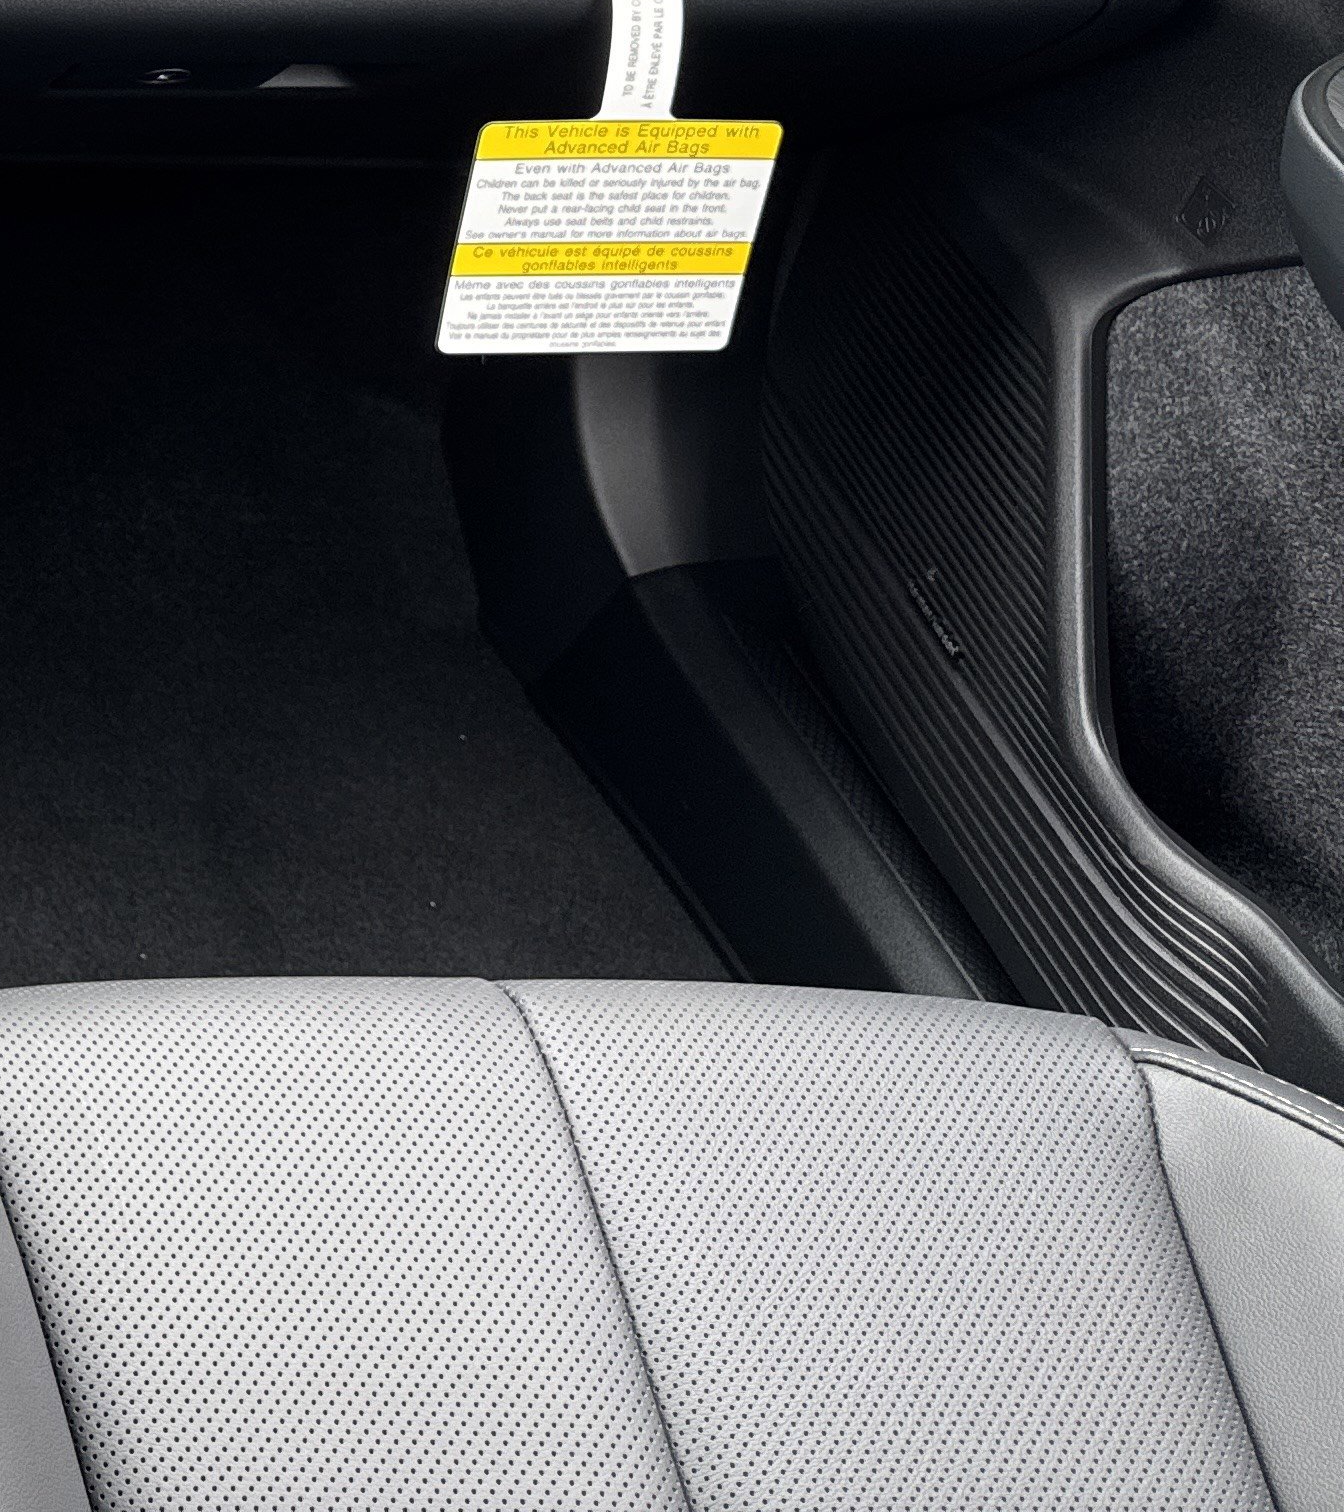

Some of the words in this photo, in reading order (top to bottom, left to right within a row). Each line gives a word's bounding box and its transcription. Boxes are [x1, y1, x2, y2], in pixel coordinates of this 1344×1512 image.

[504, 125, 539, 139] This
[547, 124, 609, 138] Vehicle
[615, 125, 630, 138] is
[637, 124, 719, 141] Equipped
[725, 125, 760, 138] with
[543, 140, 630, 155] Advanced
[634, 139, 661, 154] Air
[666, 139, 711, 158] Bags
[514, 162, 551, 175] Even
[557, 162, 586, 174] with
[590, 162, 662, 174] Advanced
[667, 162, 689, 174] Air
[693, 162, 731, 176] Bags
[476, 178, 517, 189] Children
[520, 179, 540, 188] can
[543, 178, 556, 188] be
[559, 177, 585, 188] killed
[588, 179, 600, 188] or
[603, 178, 647, 189] seriously
[650, 178, 684, 189] injured
[687, 178, 700, 189] by
[703, 178, 720, 188] the
[723, 178, 737, 188] air
[502, 191, 520, 201] The
[523, 191, 548, 201] back
[551, 191, 573, 201] seat
[576, 191, 585, 201] is
[588, 191, 605, 200] the
[608, 191, 638, 201] safest
[641, 191, 669, 202] place
[672, 191, 686, 200] for
[472, 246, 494, 259] Ce
[499, 245, 559, 258] véhicule
[564, 246, 588, 258] est
[592, 245, 641, 259] équipé
[646, 246, 665, 257] de
[670, 245, 733, 257] coussins
[521, 259, 596, 274] gonflables
[601, 259, 679, 274] intelligents
[495, 281, 525, 290] avec
[528, 280, 551, 290] des
[554, 280, 606, 289] coussins
